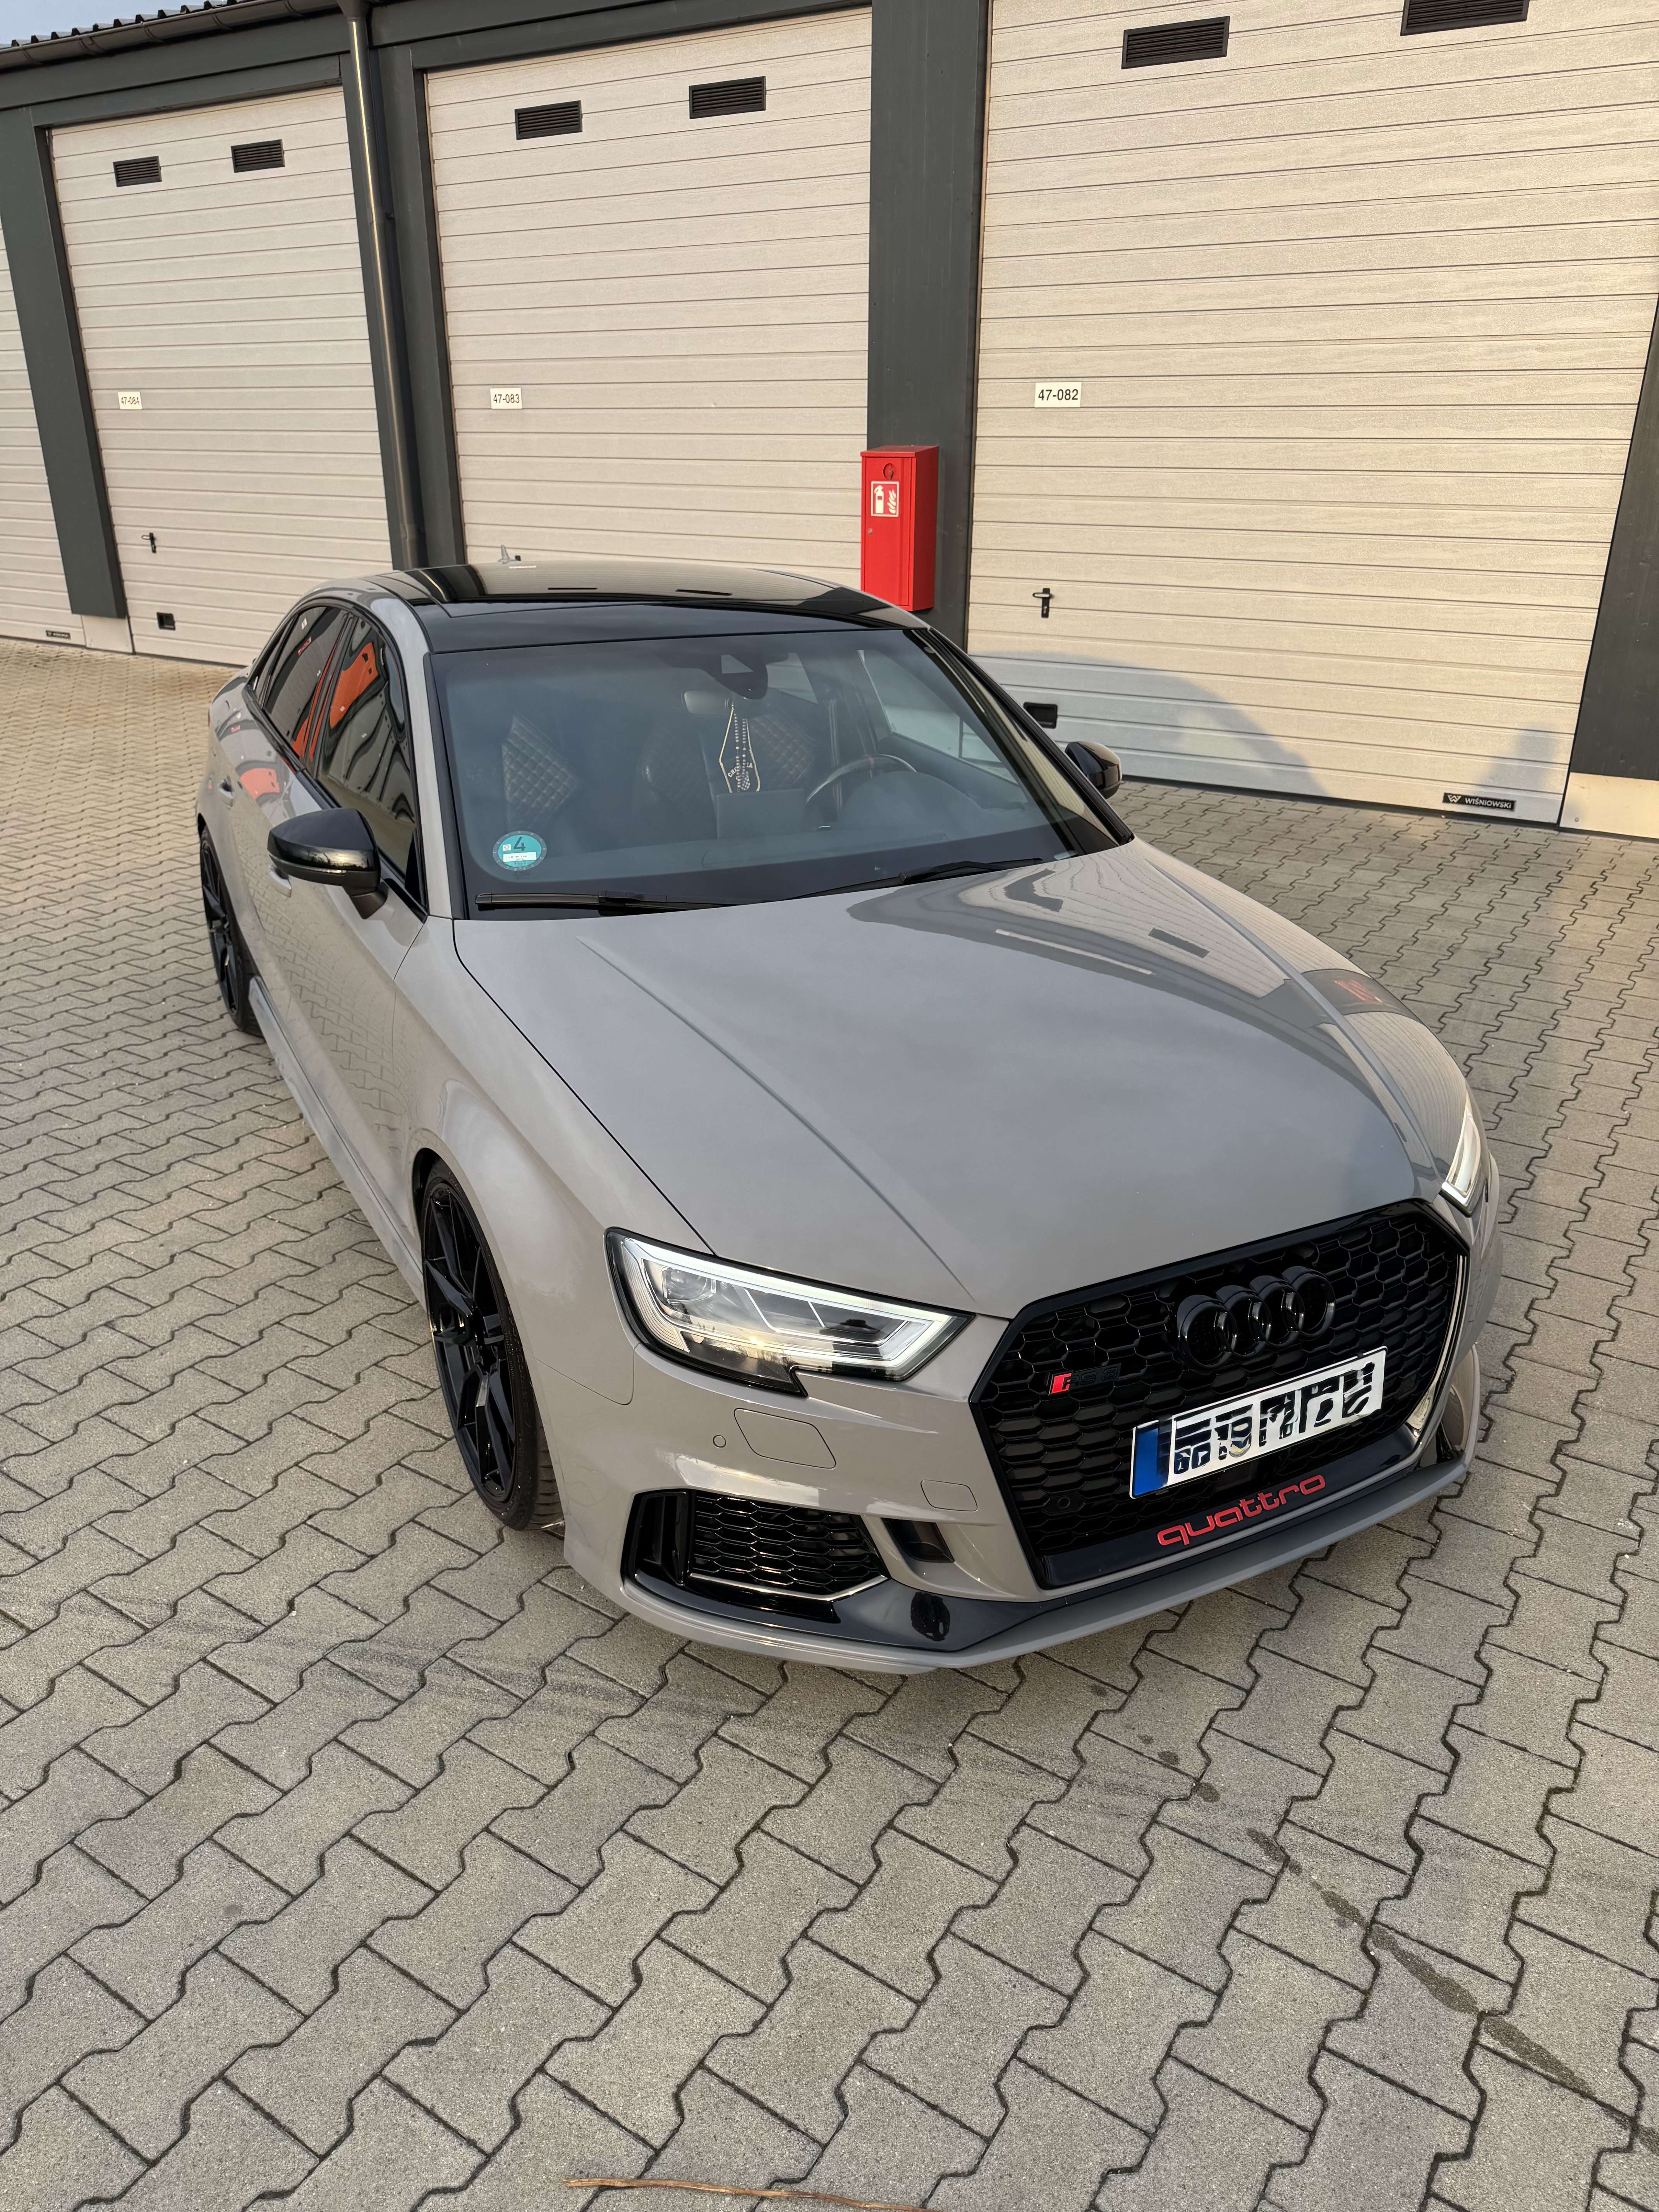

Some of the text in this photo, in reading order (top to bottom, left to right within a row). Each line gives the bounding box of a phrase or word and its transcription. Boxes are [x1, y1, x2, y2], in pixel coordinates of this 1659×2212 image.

[493, 394, 519, 403] 47-083
[1038, 389, 1079, 401] 47-082
[1465, 797, 1511, 809] WIŚNIOWSKI
[514, 836, 526, 851] 4
[1157, 1475, 1326, 1546] quattro
